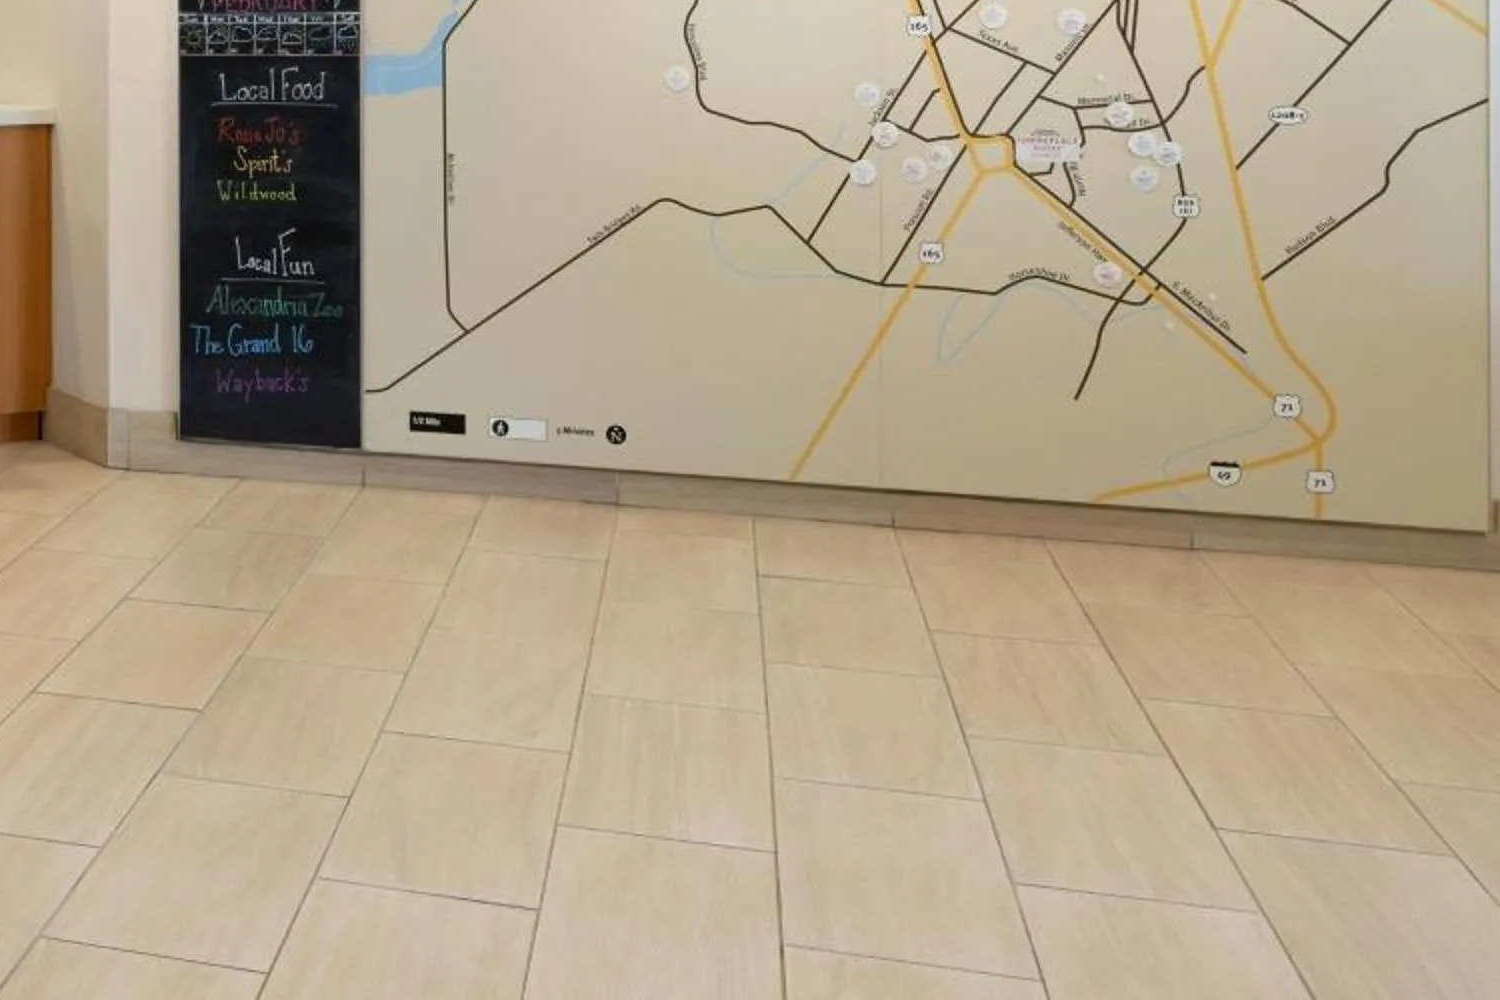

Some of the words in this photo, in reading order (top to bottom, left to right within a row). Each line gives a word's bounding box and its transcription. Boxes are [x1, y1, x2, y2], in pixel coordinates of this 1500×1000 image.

[910, 22, 929, 33] 165
[218, 67, 275, 101] Local
[280, 66, 327, 101] Food
[216, 179, 298, 202] Wildwood
[234, 236, 277, 275] Local
[278, 227, 316, 277] Fun
[206, 282, 308, 317] Alexandria
[313, 292, 345, 318] Zoo
[189, 324, 224, 356] The
[227, 323, 281, 356] Grand
[291, 325, 314, 355] 16
[216, 368, 310, 404] Wayback's
